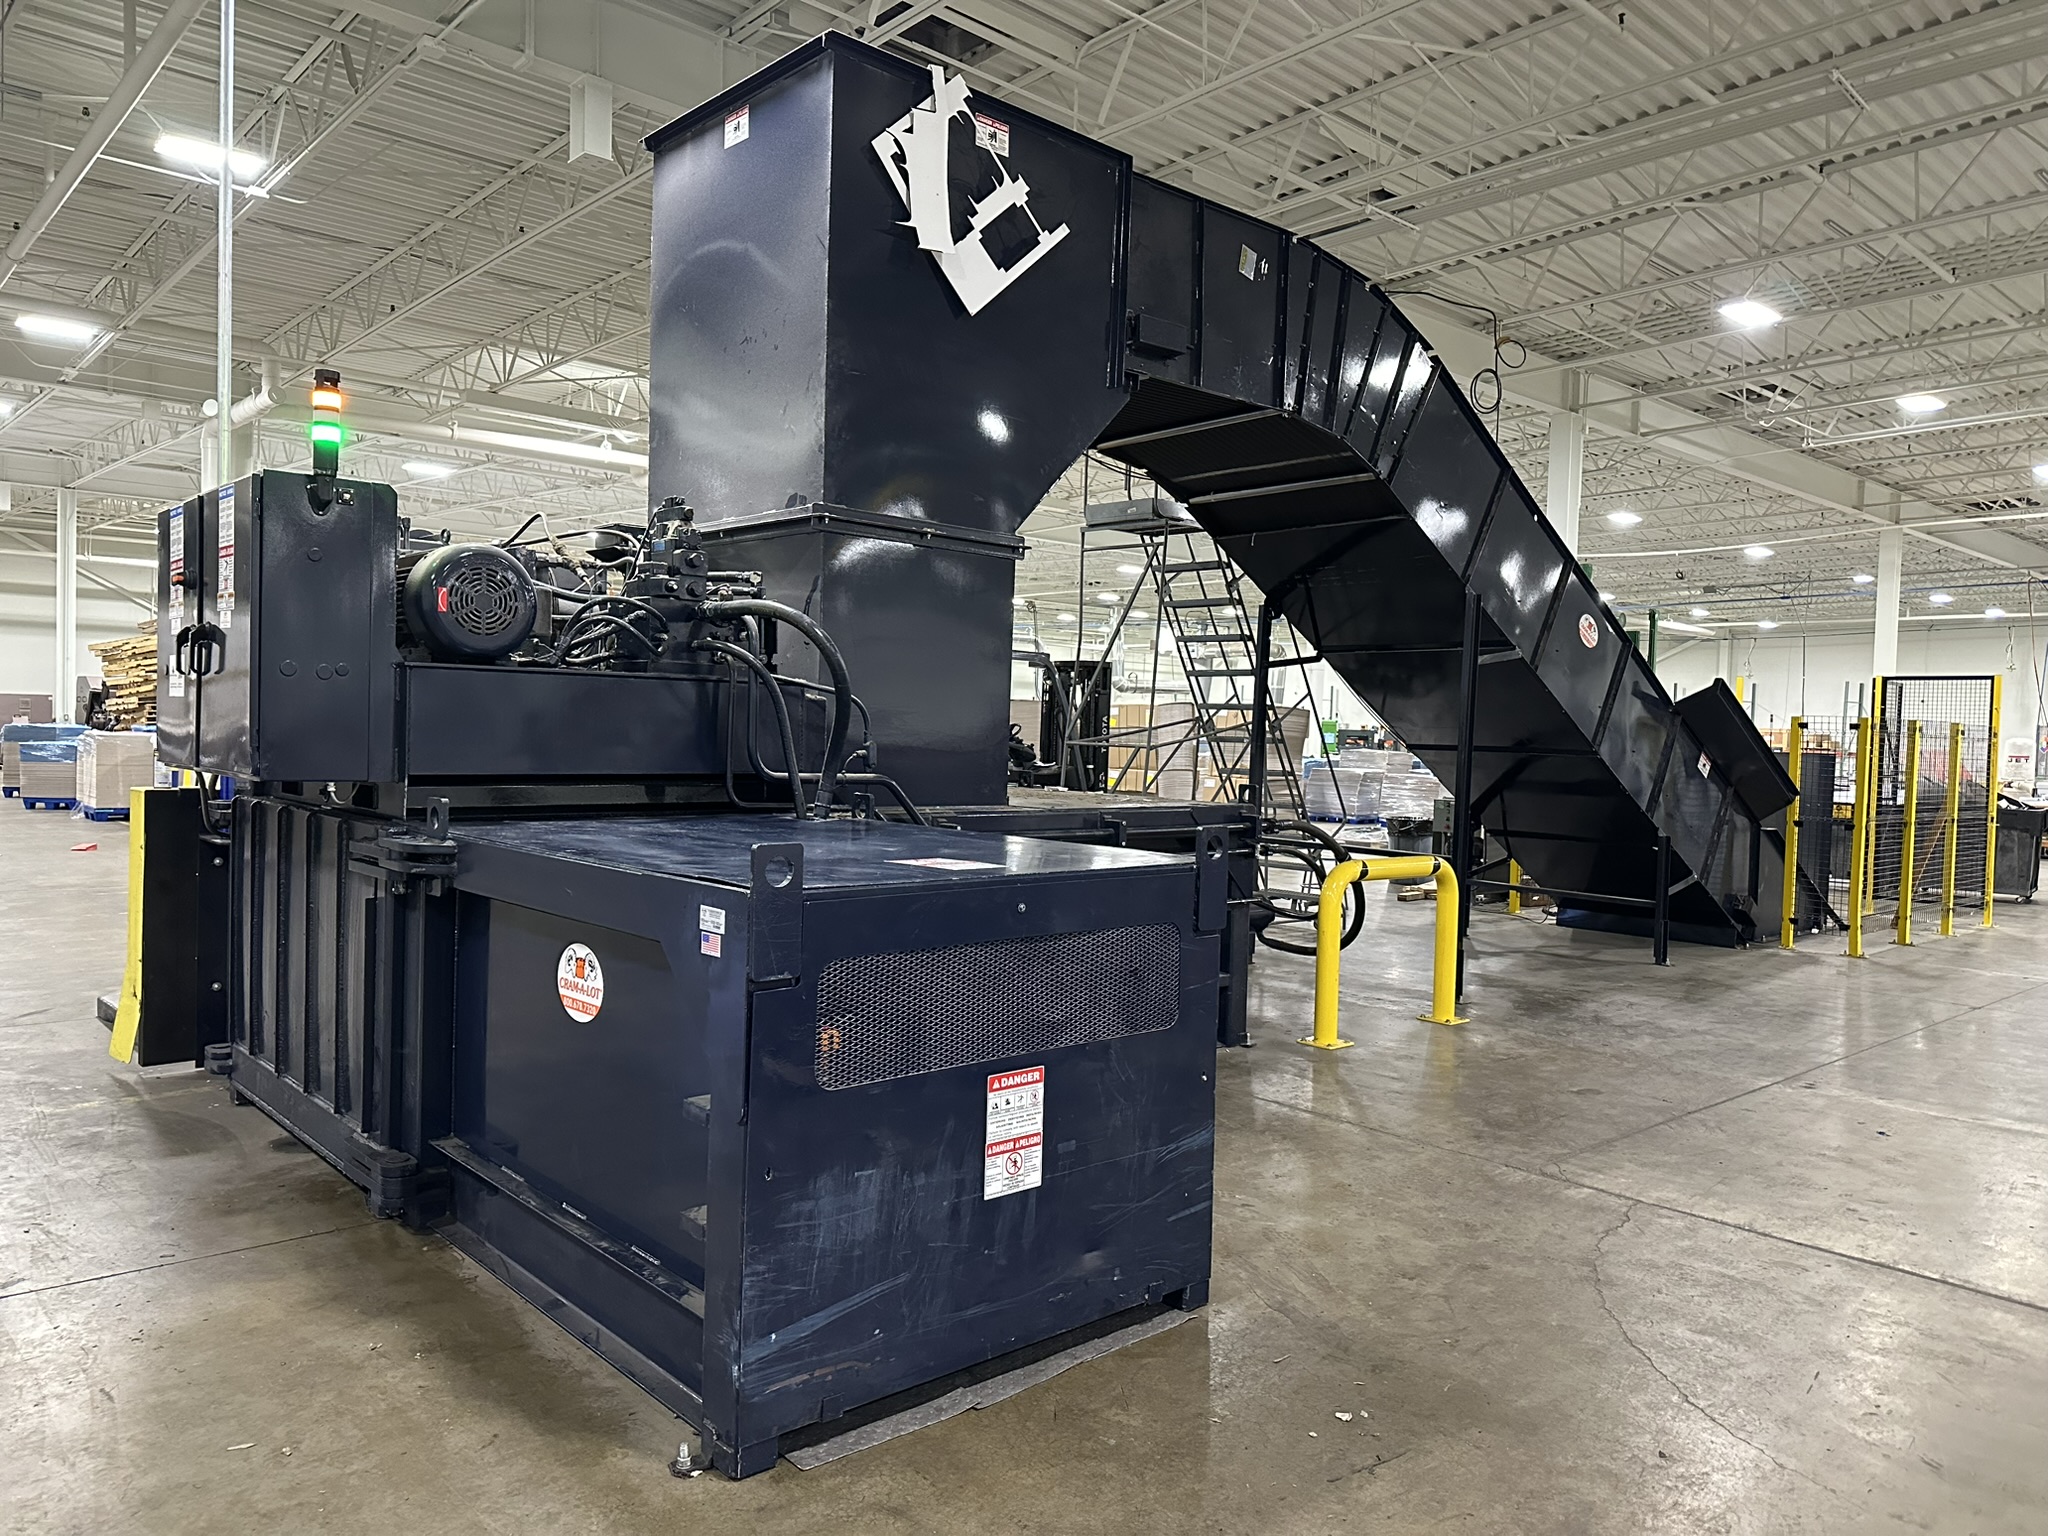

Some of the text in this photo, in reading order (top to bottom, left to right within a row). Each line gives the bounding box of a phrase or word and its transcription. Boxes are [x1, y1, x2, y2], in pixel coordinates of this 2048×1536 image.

[559, 976, 602, 1000] CRAM-A-LOT
[1000, 1071, 1040, 1087] DANGER
[992, 1135, 1041, 1154] DANGER PELIGRO
